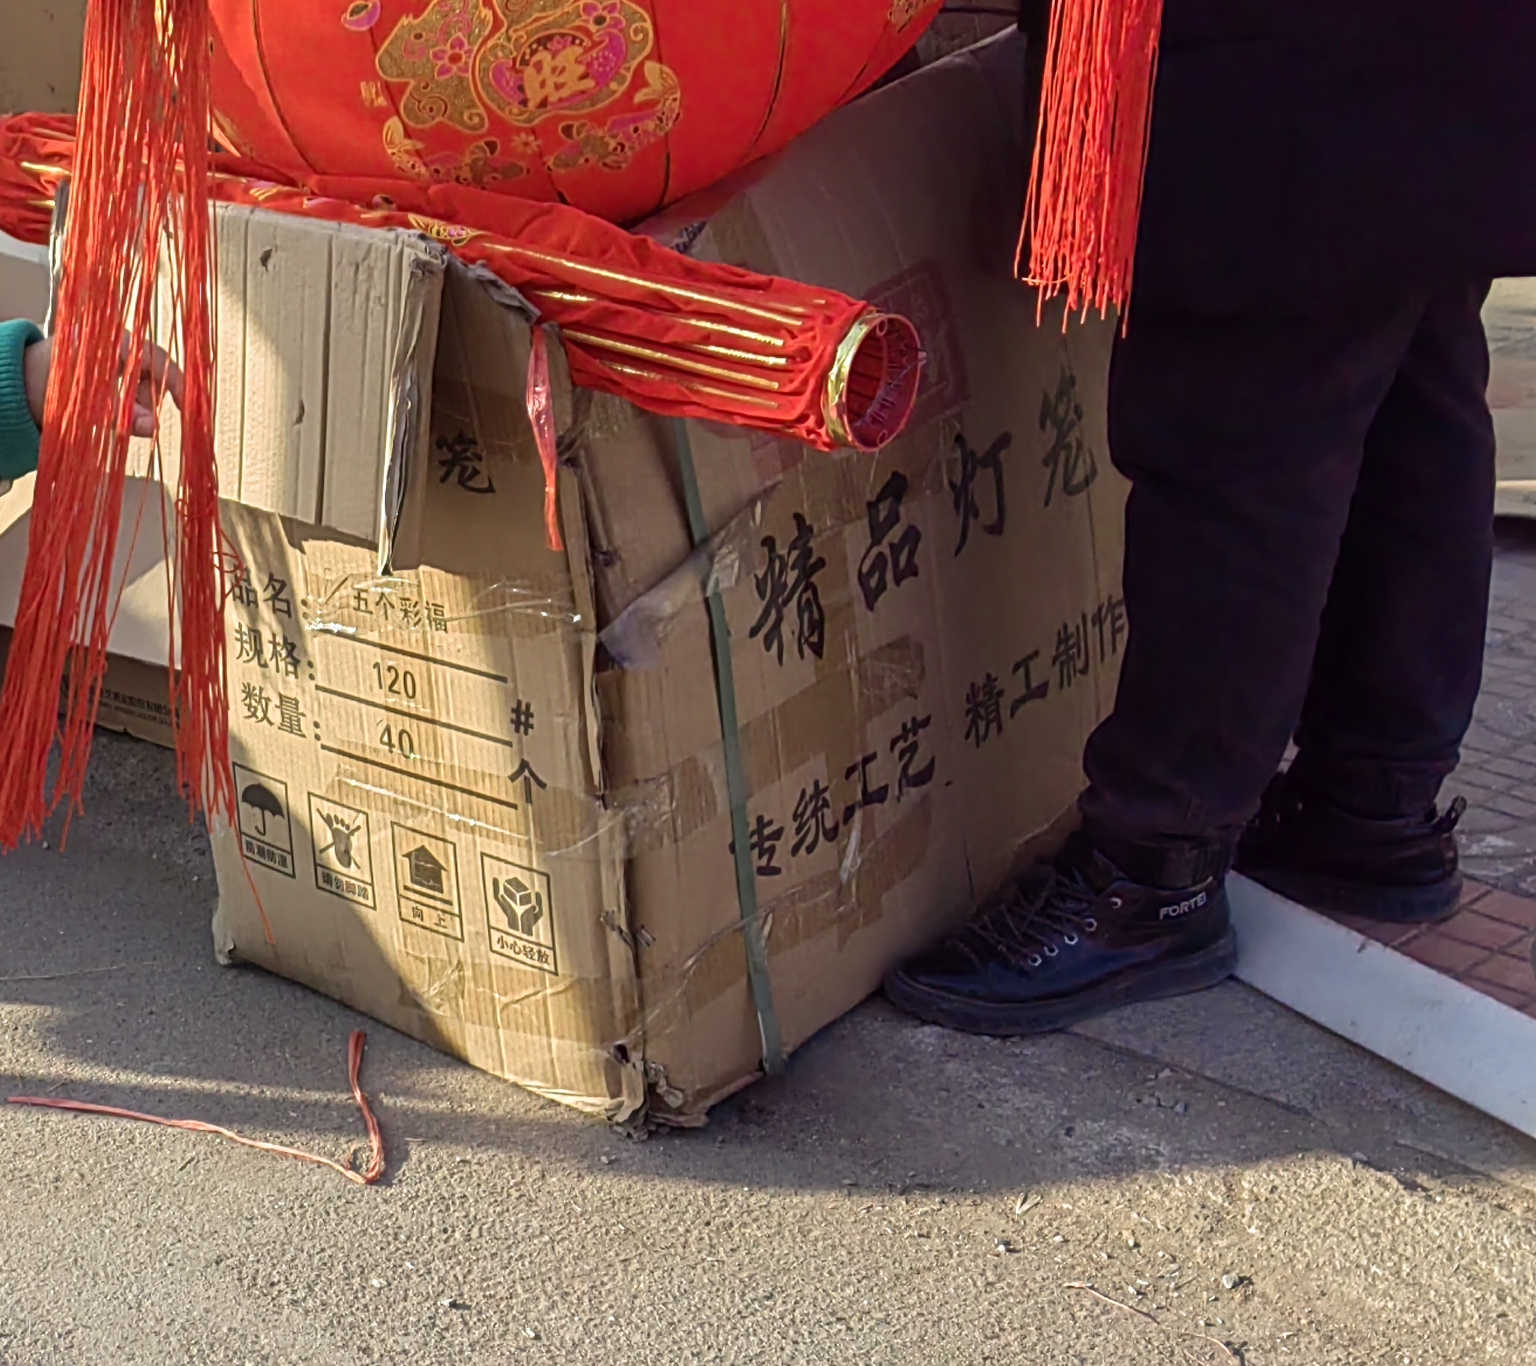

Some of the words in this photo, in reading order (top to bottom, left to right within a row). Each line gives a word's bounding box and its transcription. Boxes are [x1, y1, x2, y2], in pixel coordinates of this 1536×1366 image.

[749, 364, 1098, 668] 精品灯笼
[351, 587, 448, 634] 五个彩福
[372, 661, 417, 700] 120
[729, 713, 936, 878] 传统工艺
[964, 593, 1126, 750] 精工制作
[379, 723, 415, 760] 40
[507, 758, 548, 805] 个
[411, 905, 448, 930] 向上
[496, 935, 551, 966] 小心轻放
